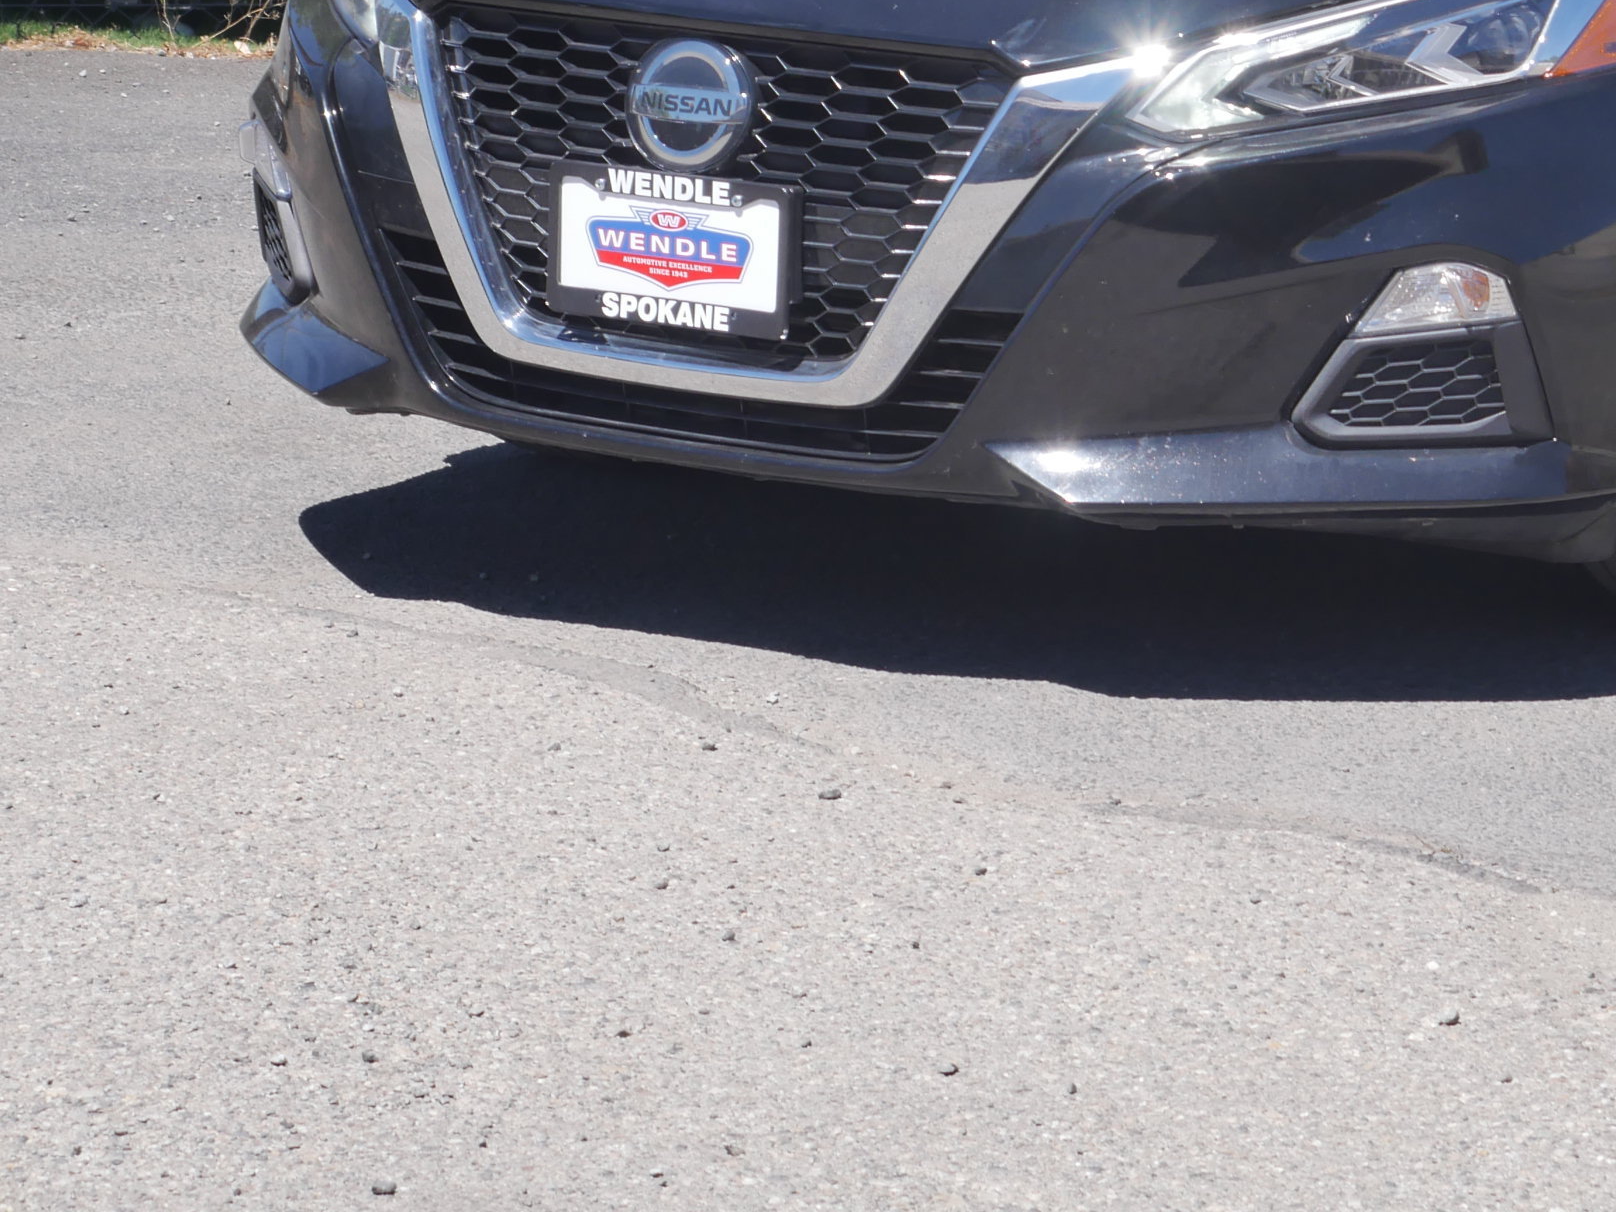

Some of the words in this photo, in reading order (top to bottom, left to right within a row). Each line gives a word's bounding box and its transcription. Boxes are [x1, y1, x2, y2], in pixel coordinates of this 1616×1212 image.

[640, 91, 732, 117] NISSAN
[608, 168, 731, 206] WENDLE
[598, 228, 737, 262] WENDLE
[623, 255, 668, 268] AUTOMOTIVE
[668, 261, 713, 273] EXCELLENCE
[649, 267, 670, 276] SINCE
[601, 291, 730, 332] SPOKANE
